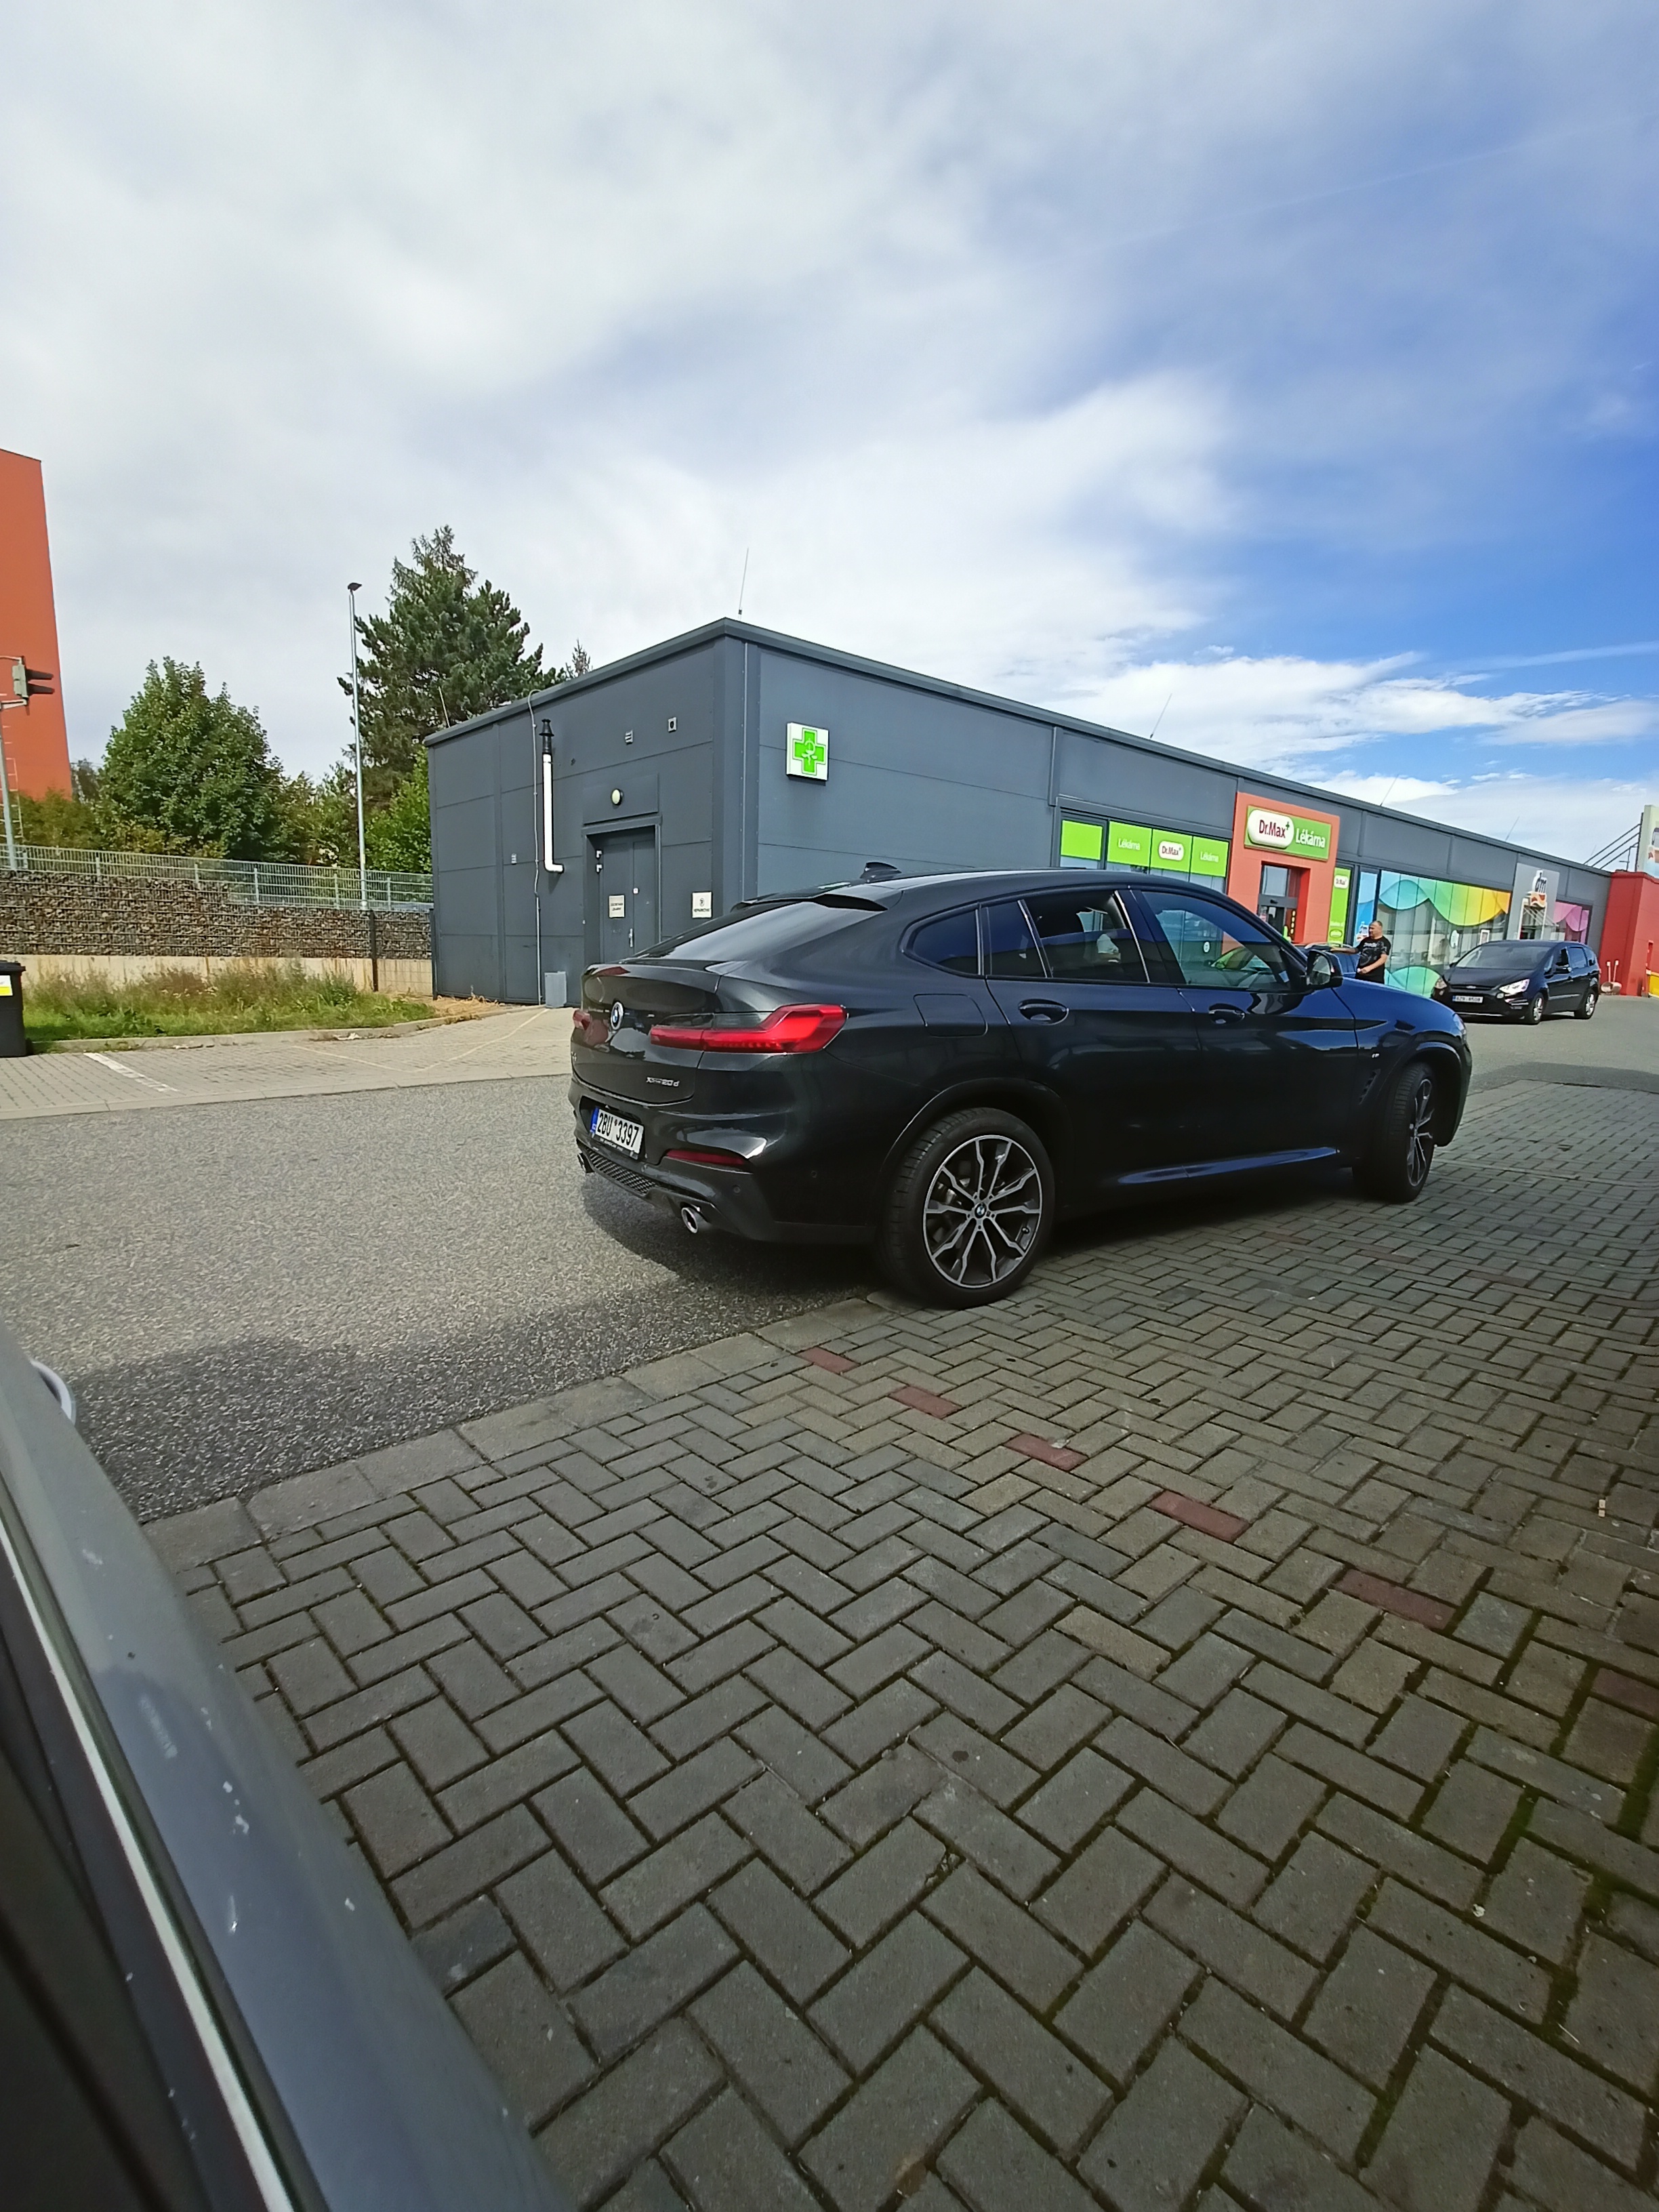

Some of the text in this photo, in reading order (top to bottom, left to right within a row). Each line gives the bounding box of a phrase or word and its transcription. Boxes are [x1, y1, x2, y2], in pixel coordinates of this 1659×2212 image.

[1258, 819, 1326, 848] Dr.Max Lékárna
[1162, 845, 1179, 856] Dr.Max
[1535, 872, 1547, 893] dm
[597, 1112, 613, 1136] 2BU
[615, 1120, 639, 1147] 3397
